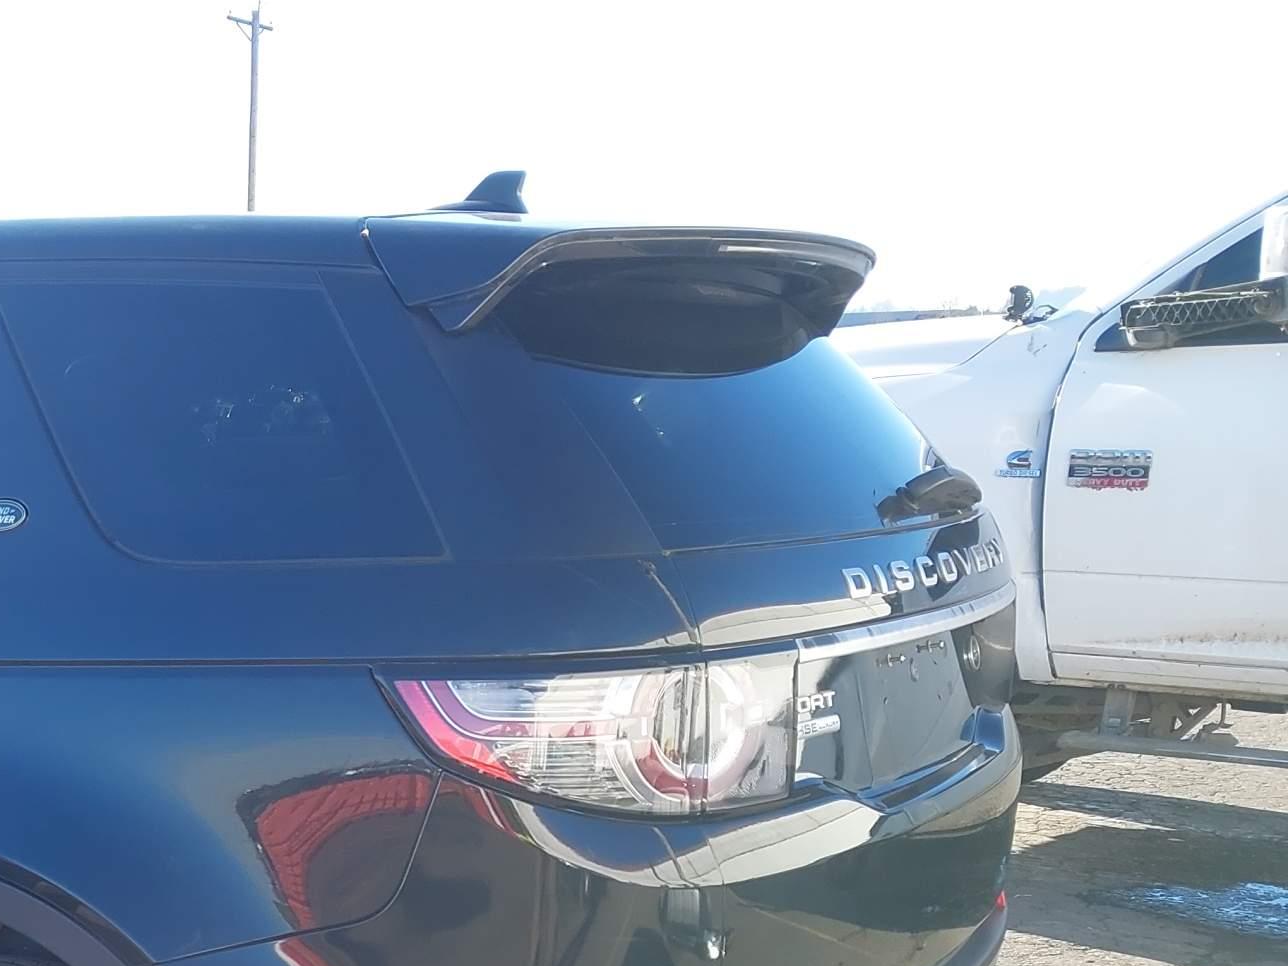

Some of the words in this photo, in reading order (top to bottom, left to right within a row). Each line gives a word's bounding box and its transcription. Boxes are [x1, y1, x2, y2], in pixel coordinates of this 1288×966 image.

[1074, 466, 1145, 477] 3500
[841, 538, 1004, 598] DISCOVERY
[797, 690, 836, 712] ORT
